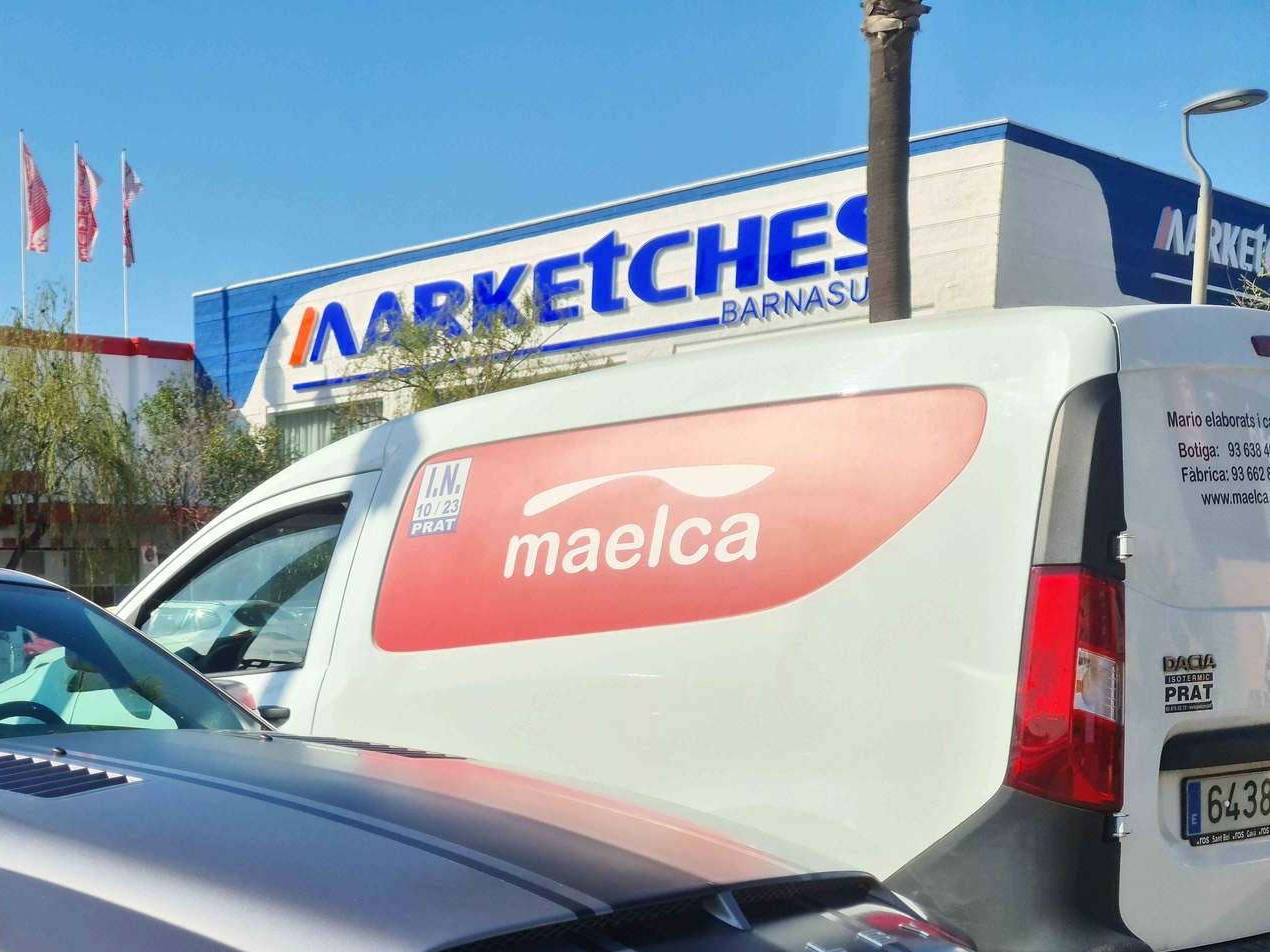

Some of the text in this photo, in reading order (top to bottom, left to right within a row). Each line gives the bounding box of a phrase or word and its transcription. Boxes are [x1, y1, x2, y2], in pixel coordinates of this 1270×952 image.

[1167, 411, 1202, 427] Mario
[1205, 411, 1256, 428] elaborats
[1257, 413, 1261, 428] i
[1178, 442, 1270, 462] Botiga: 93 638 4
[425, 463, 461, 498] I.N.
[1181, 466, 1229, 483] Fàbrica:
[1231, 466, 1245, 482] 93
[1246, 466, 1265, 482] 662
[1201, 489, 1269, 505] www.maelca
[411, 518, 457, 535] PRAT
[503, 503, 761, 579] maelca
[1162, 653, 1217, 672] DACIA
[1168, 673, 1210, 683] ISOTERMIC
[1165, 684, 1213, 702] PRAT
[1191, 778, 1270, 825] E 6438
[1212, 834, 1223, 843] Sant
